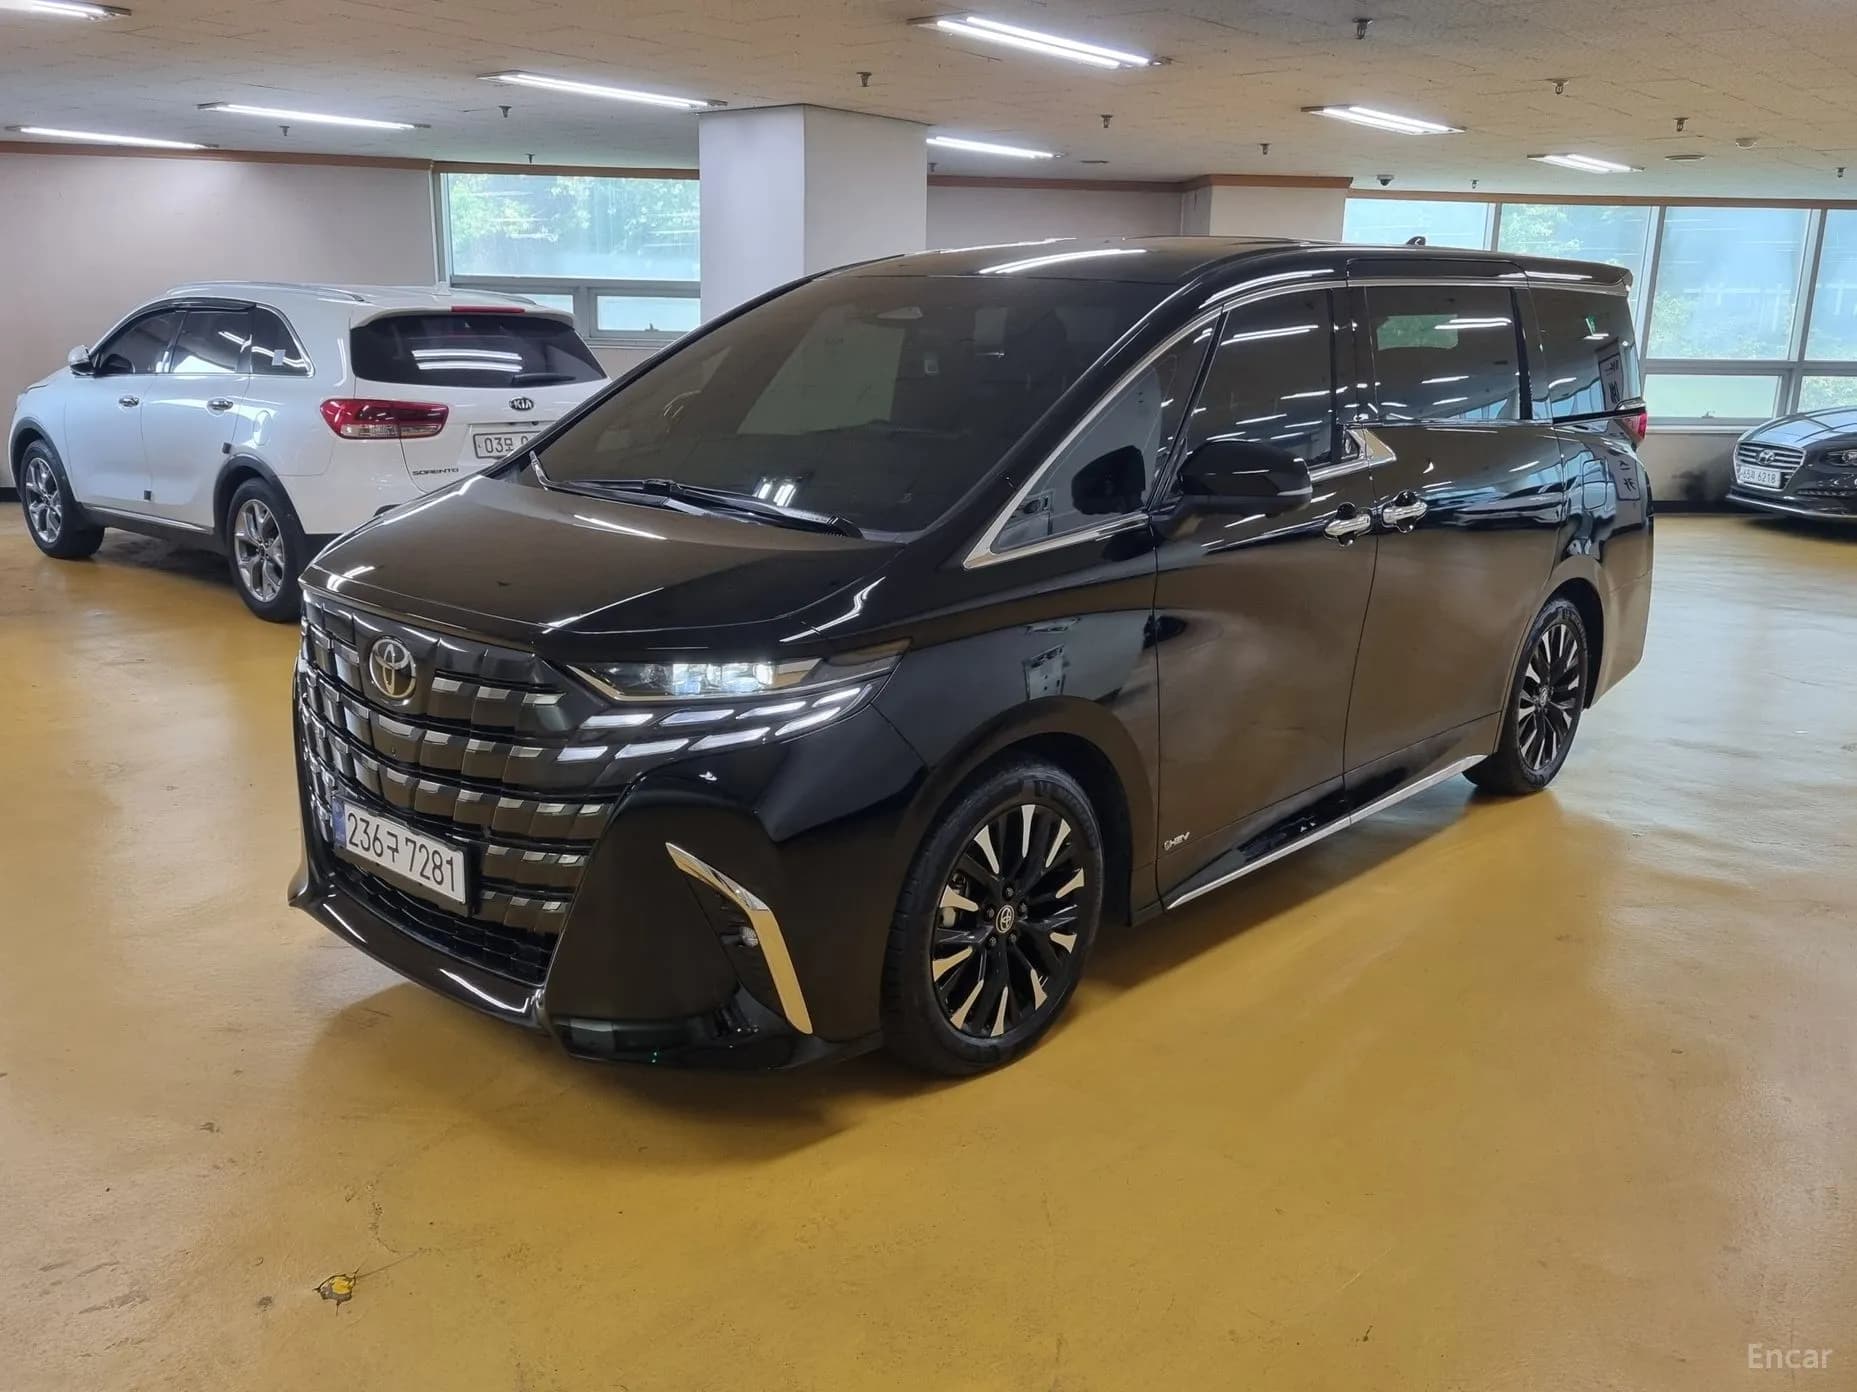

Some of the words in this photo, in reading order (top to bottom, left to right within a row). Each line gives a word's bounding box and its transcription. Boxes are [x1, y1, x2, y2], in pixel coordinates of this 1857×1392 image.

[514, 398, 532, 409] KIA
[412, 467, 459, 476] SORENTO
[1758, 471, 1777, 484] 6218
[347, 812, 399, 863] 236구
[405, 836, 455, 892] 7281
